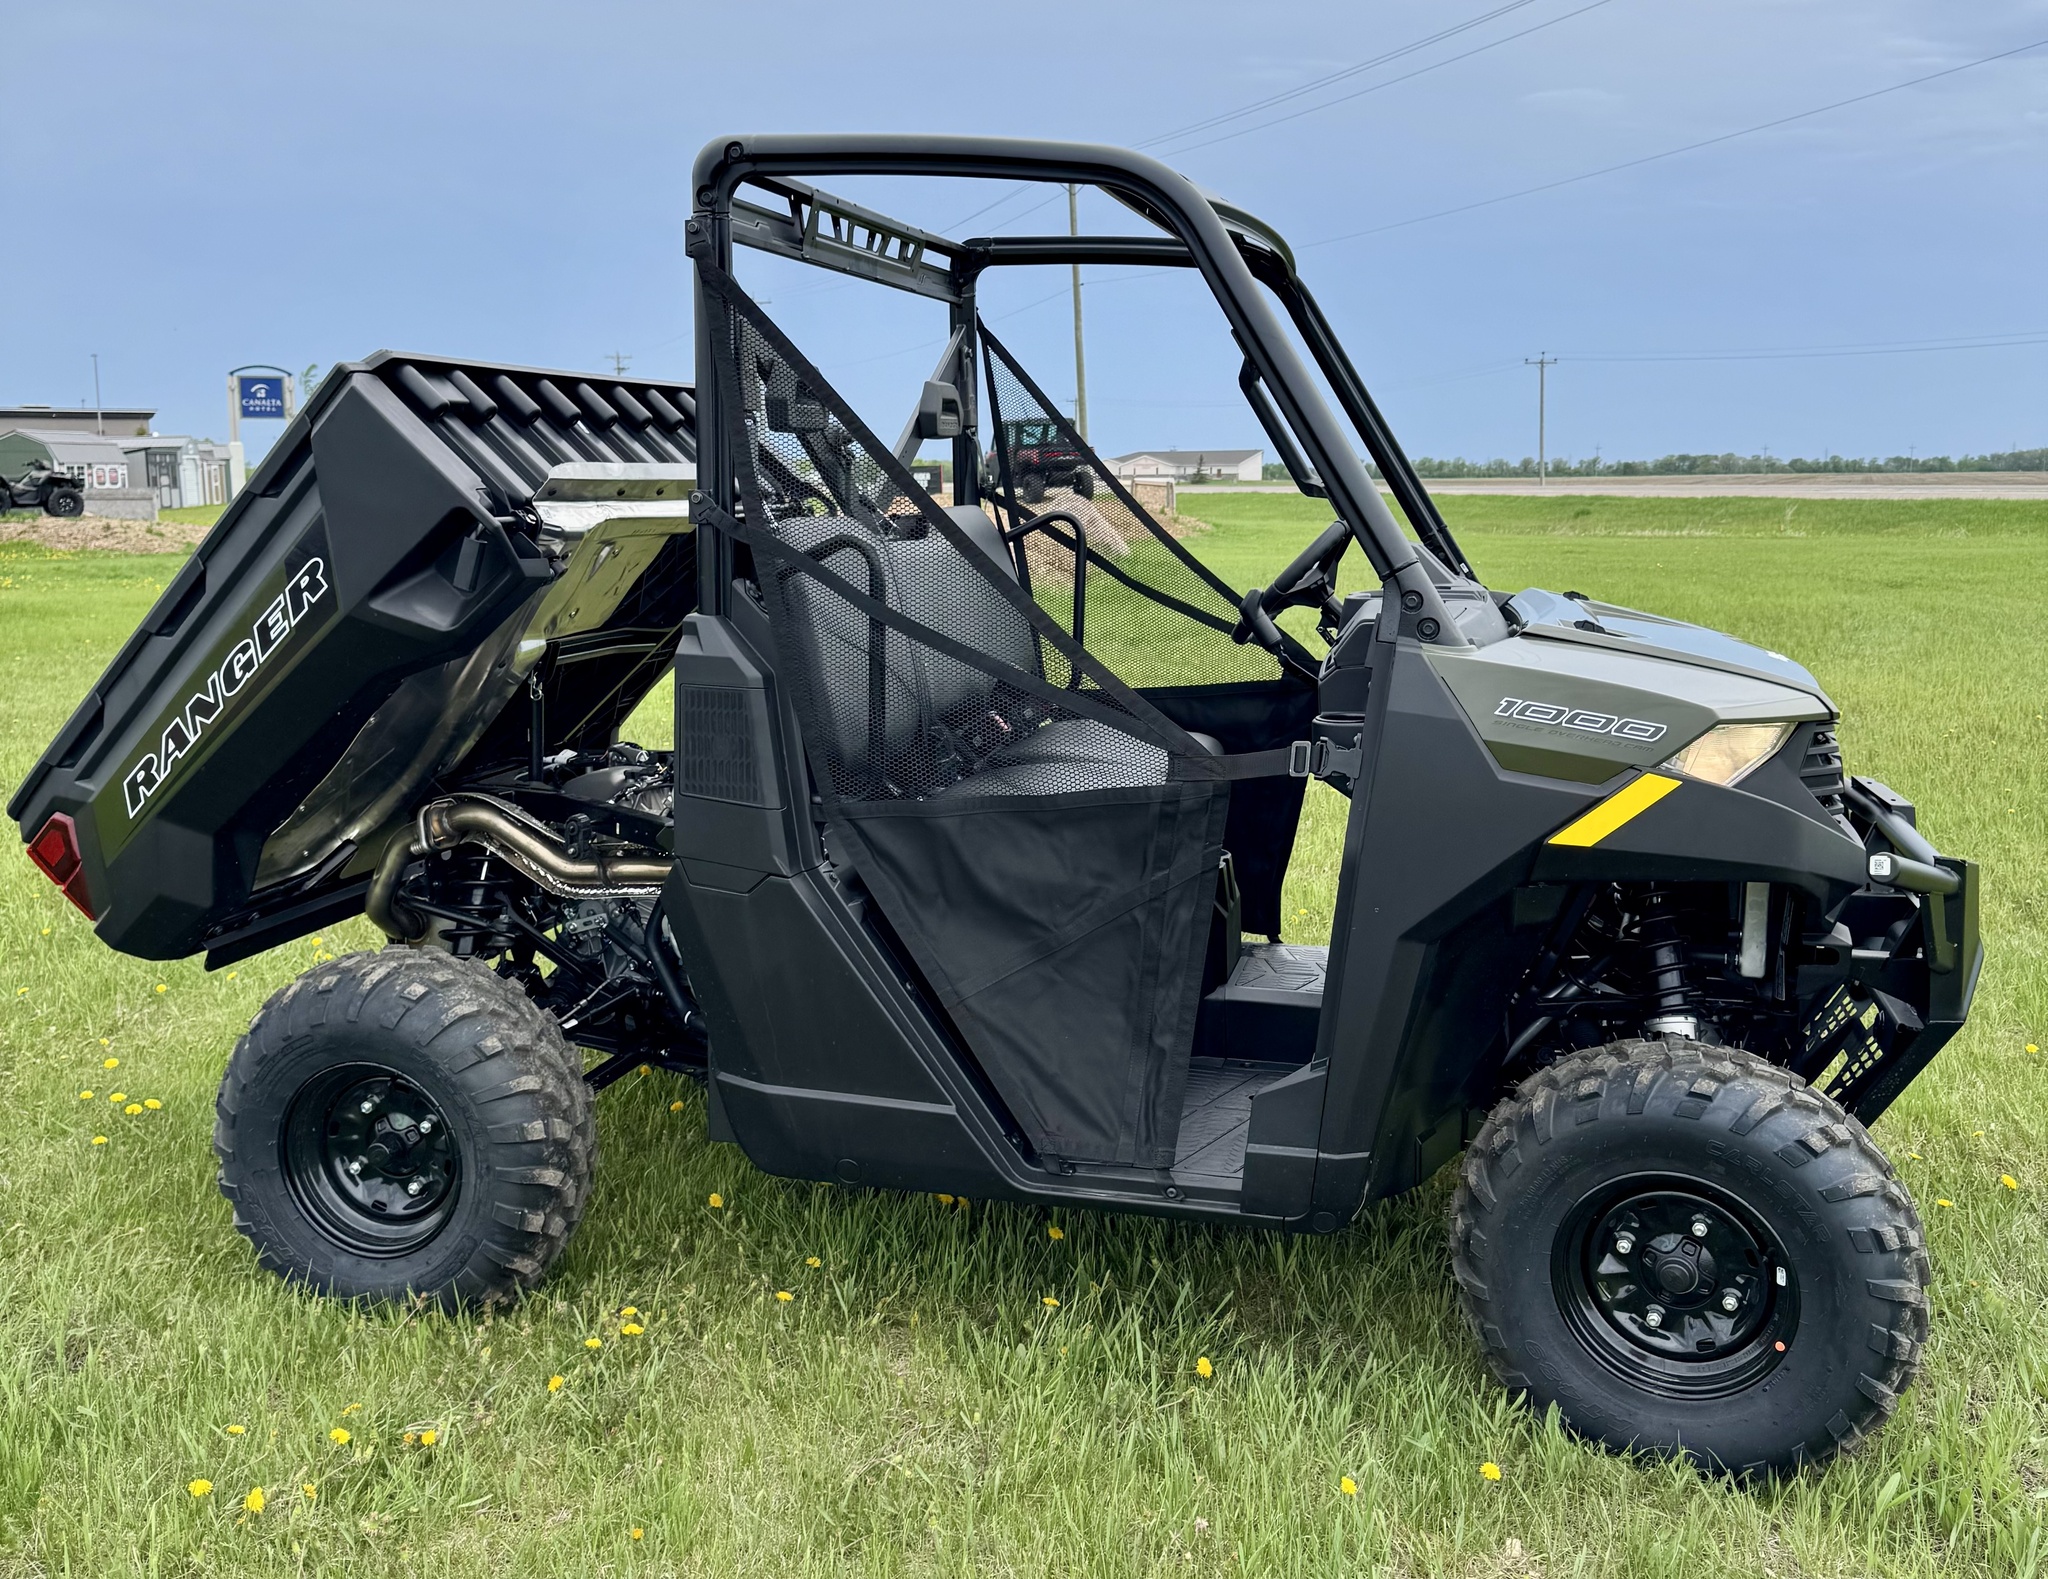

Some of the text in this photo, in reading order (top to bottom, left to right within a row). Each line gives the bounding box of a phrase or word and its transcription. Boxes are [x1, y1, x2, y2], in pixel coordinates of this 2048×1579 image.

[242, 398, 282, 407] CANALTA
[123, 557, 328, 819] RANGER
[1494, 697, 1667, 742] 1000
[1491, 719, 1655, 753] SINGLE OVERHEAD CAM
[1706, 1139, 1832, 1243] CARLSTAR
[1524, 1339, 1635, 1433] AT489
